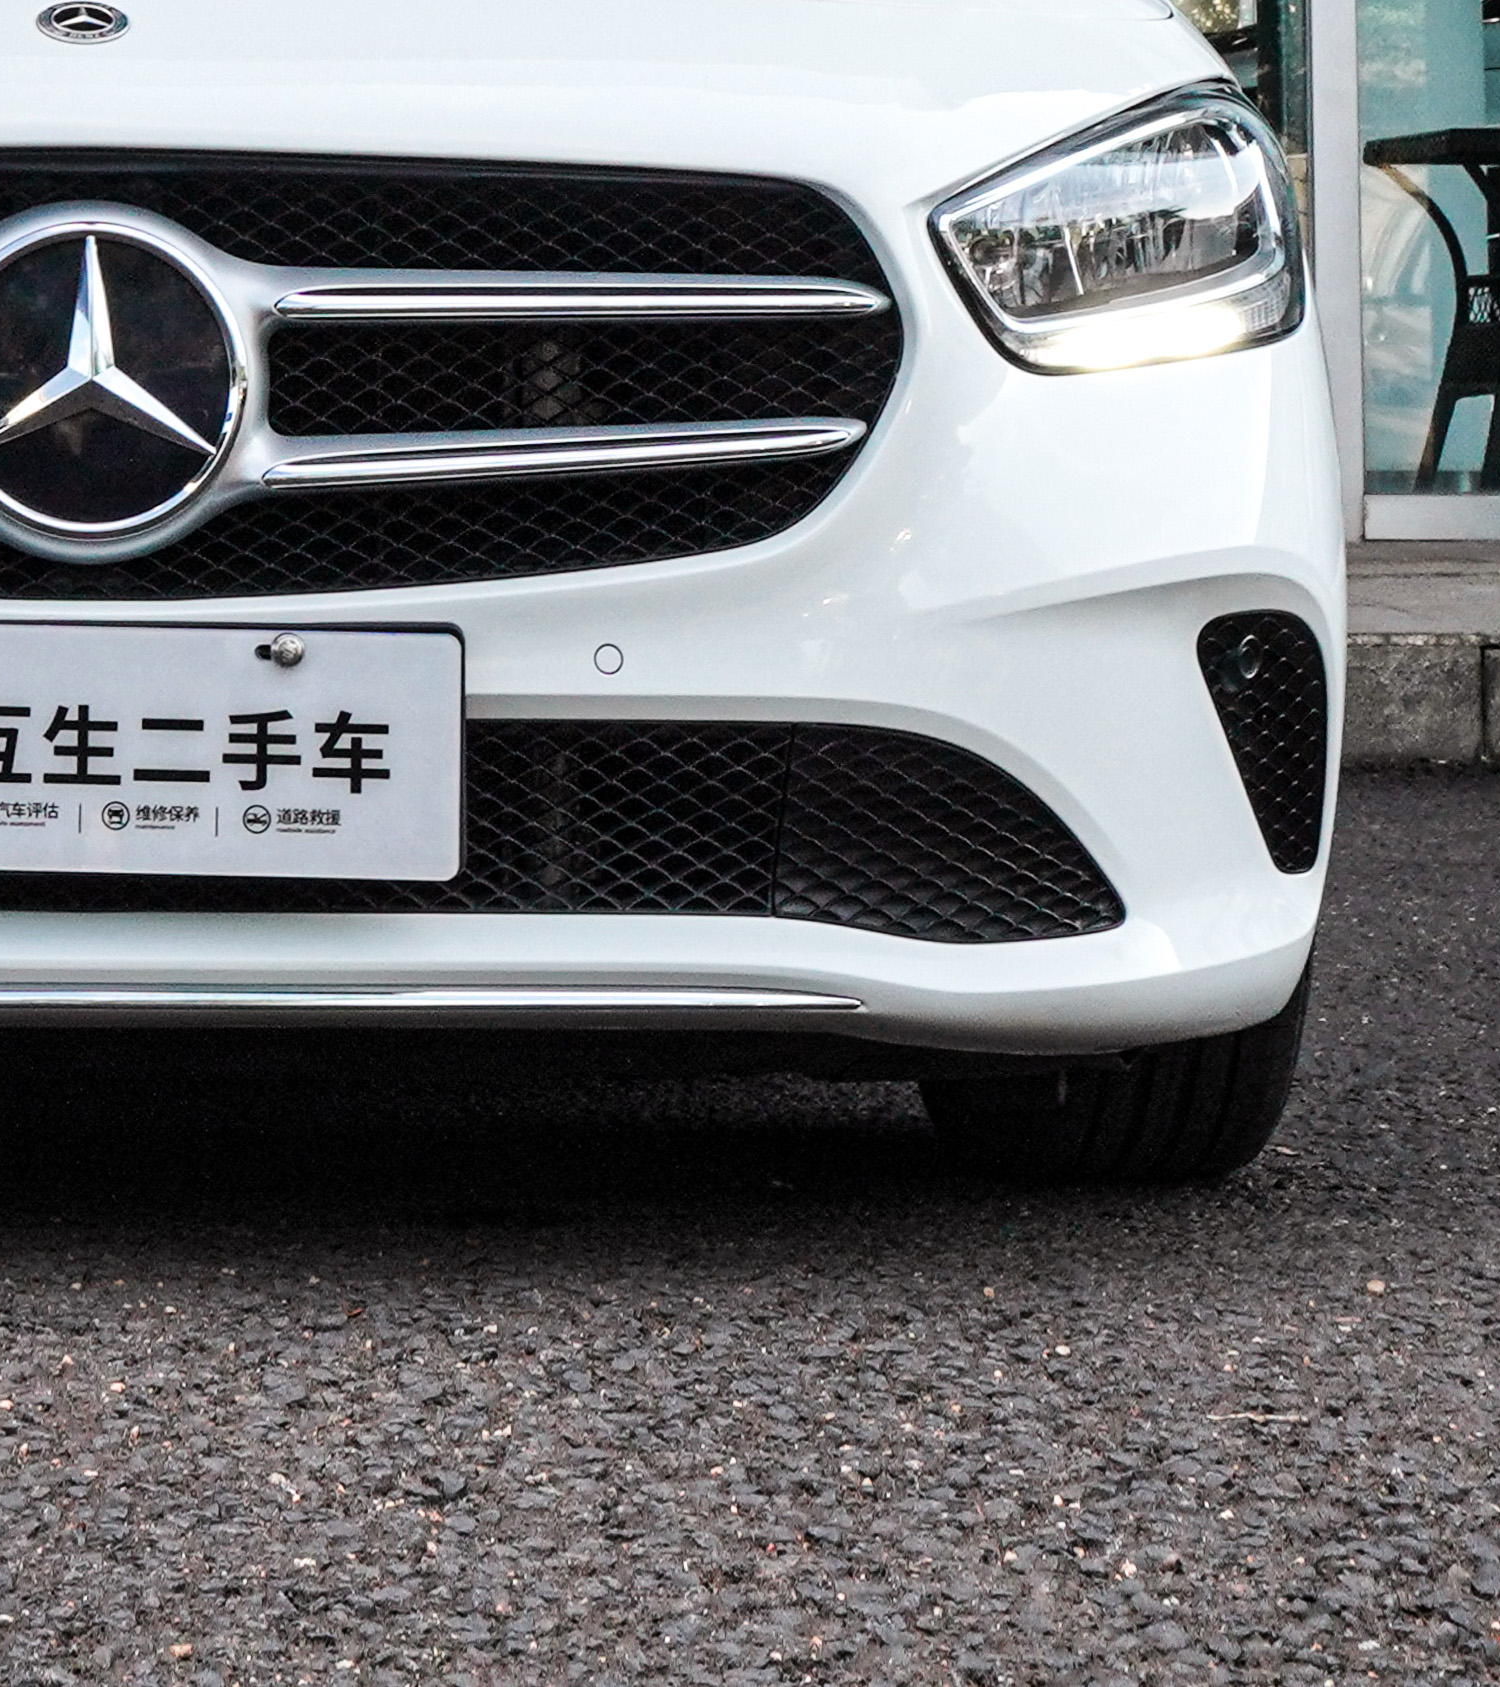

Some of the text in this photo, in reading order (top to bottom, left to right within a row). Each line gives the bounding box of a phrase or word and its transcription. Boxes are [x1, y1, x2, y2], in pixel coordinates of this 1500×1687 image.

[135, 804, 200, 823] 维修保养
[276, 808, 342, 826] 道路救援
